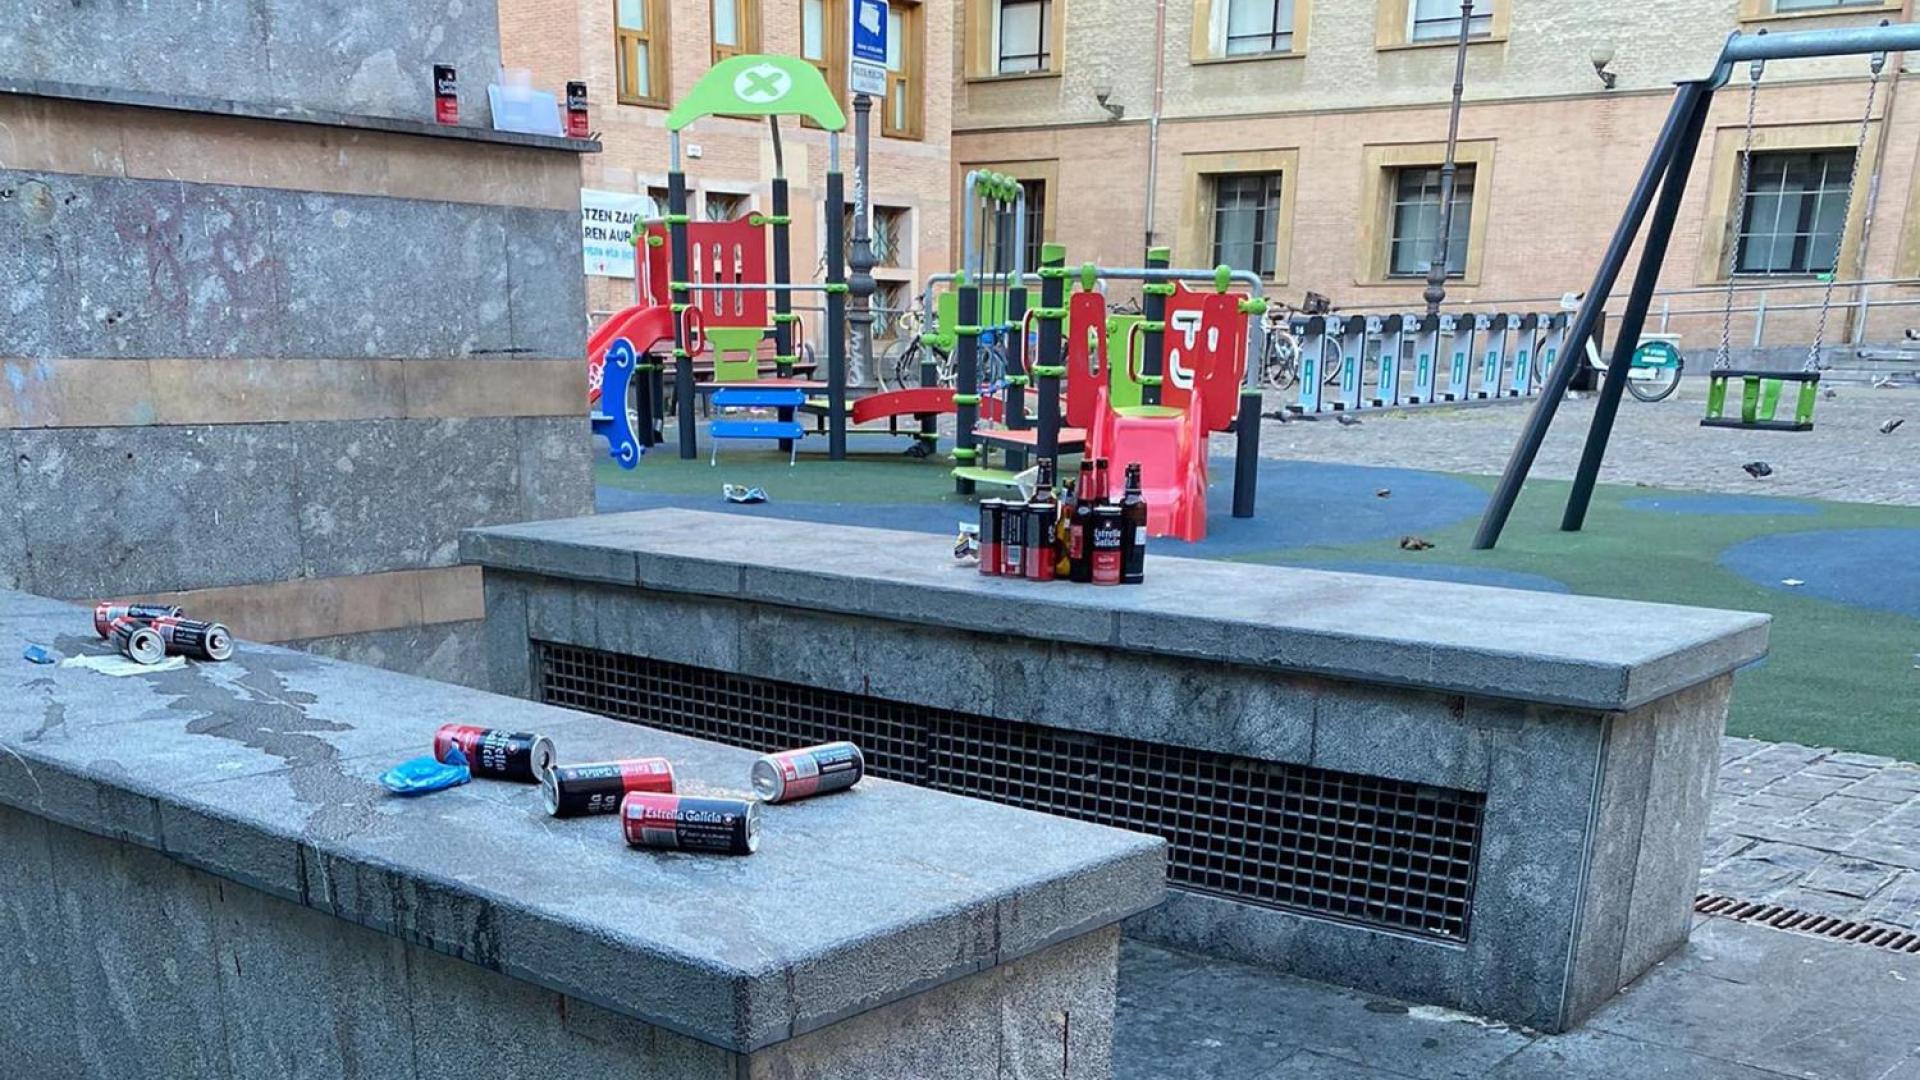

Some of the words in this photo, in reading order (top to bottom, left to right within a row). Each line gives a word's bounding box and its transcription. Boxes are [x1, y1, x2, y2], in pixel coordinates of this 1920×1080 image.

[582, 207, 613, 223] TZEN
[583, 226, 607, 240] REN
[645, 806, 684, 821] Estrella
[685, 809, 722, 824] Galicia
